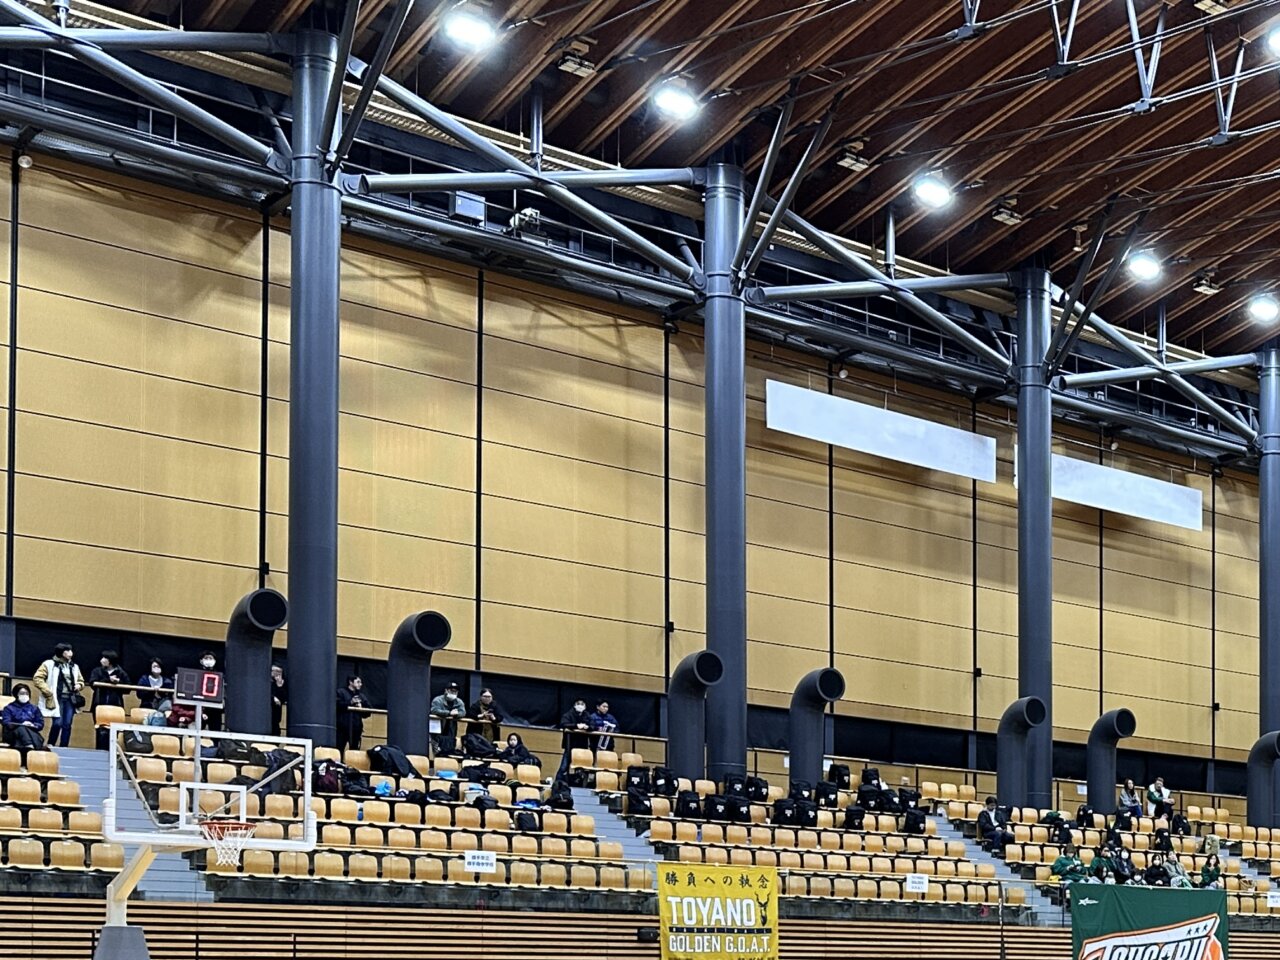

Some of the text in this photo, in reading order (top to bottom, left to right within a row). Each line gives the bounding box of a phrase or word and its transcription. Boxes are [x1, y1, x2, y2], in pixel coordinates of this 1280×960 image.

[202, 673, 219, 697] 0
[665, 871, 769, 889] 勝負への執念
[666, 896, 756, 927] TOYANO
[669, 935, 771, 953] GOLDEN G.O.A.T.
